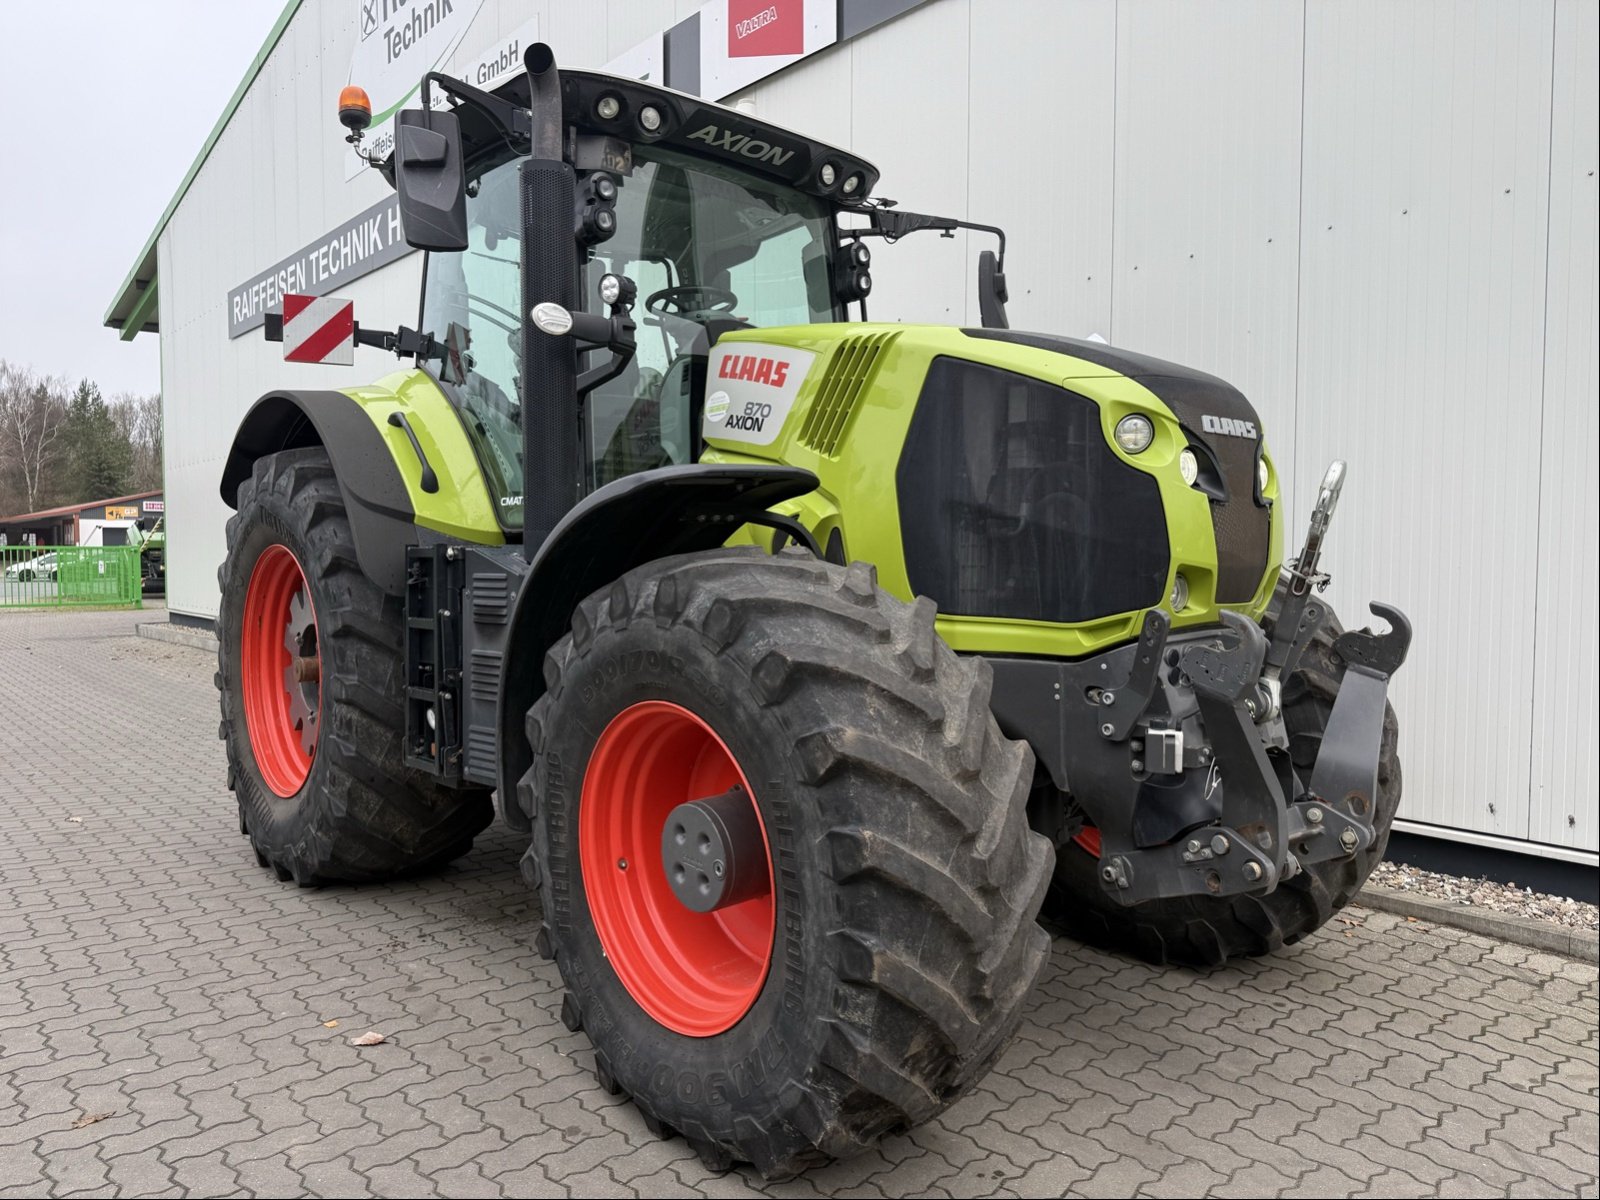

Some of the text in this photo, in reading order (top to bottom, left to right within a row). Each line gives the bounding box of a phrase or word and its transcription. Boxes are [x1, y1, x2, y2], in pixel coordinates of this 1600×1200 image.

[735, 6, 778, 40] VALTRA
[477, 39, 519, 85] GmbH
[686, 124, 795, 167] AXION
[233, 203, 405, 325] RAIFFEISEN TECHNIK H
[718, 354, 790, 388] CLAAS
[725, 414, 765, 433] AXION
[744, 401, 772, 418] 870
[1201, 414, 1257, 440] CLAAS
[500, 495, 524, 507] CMAT
